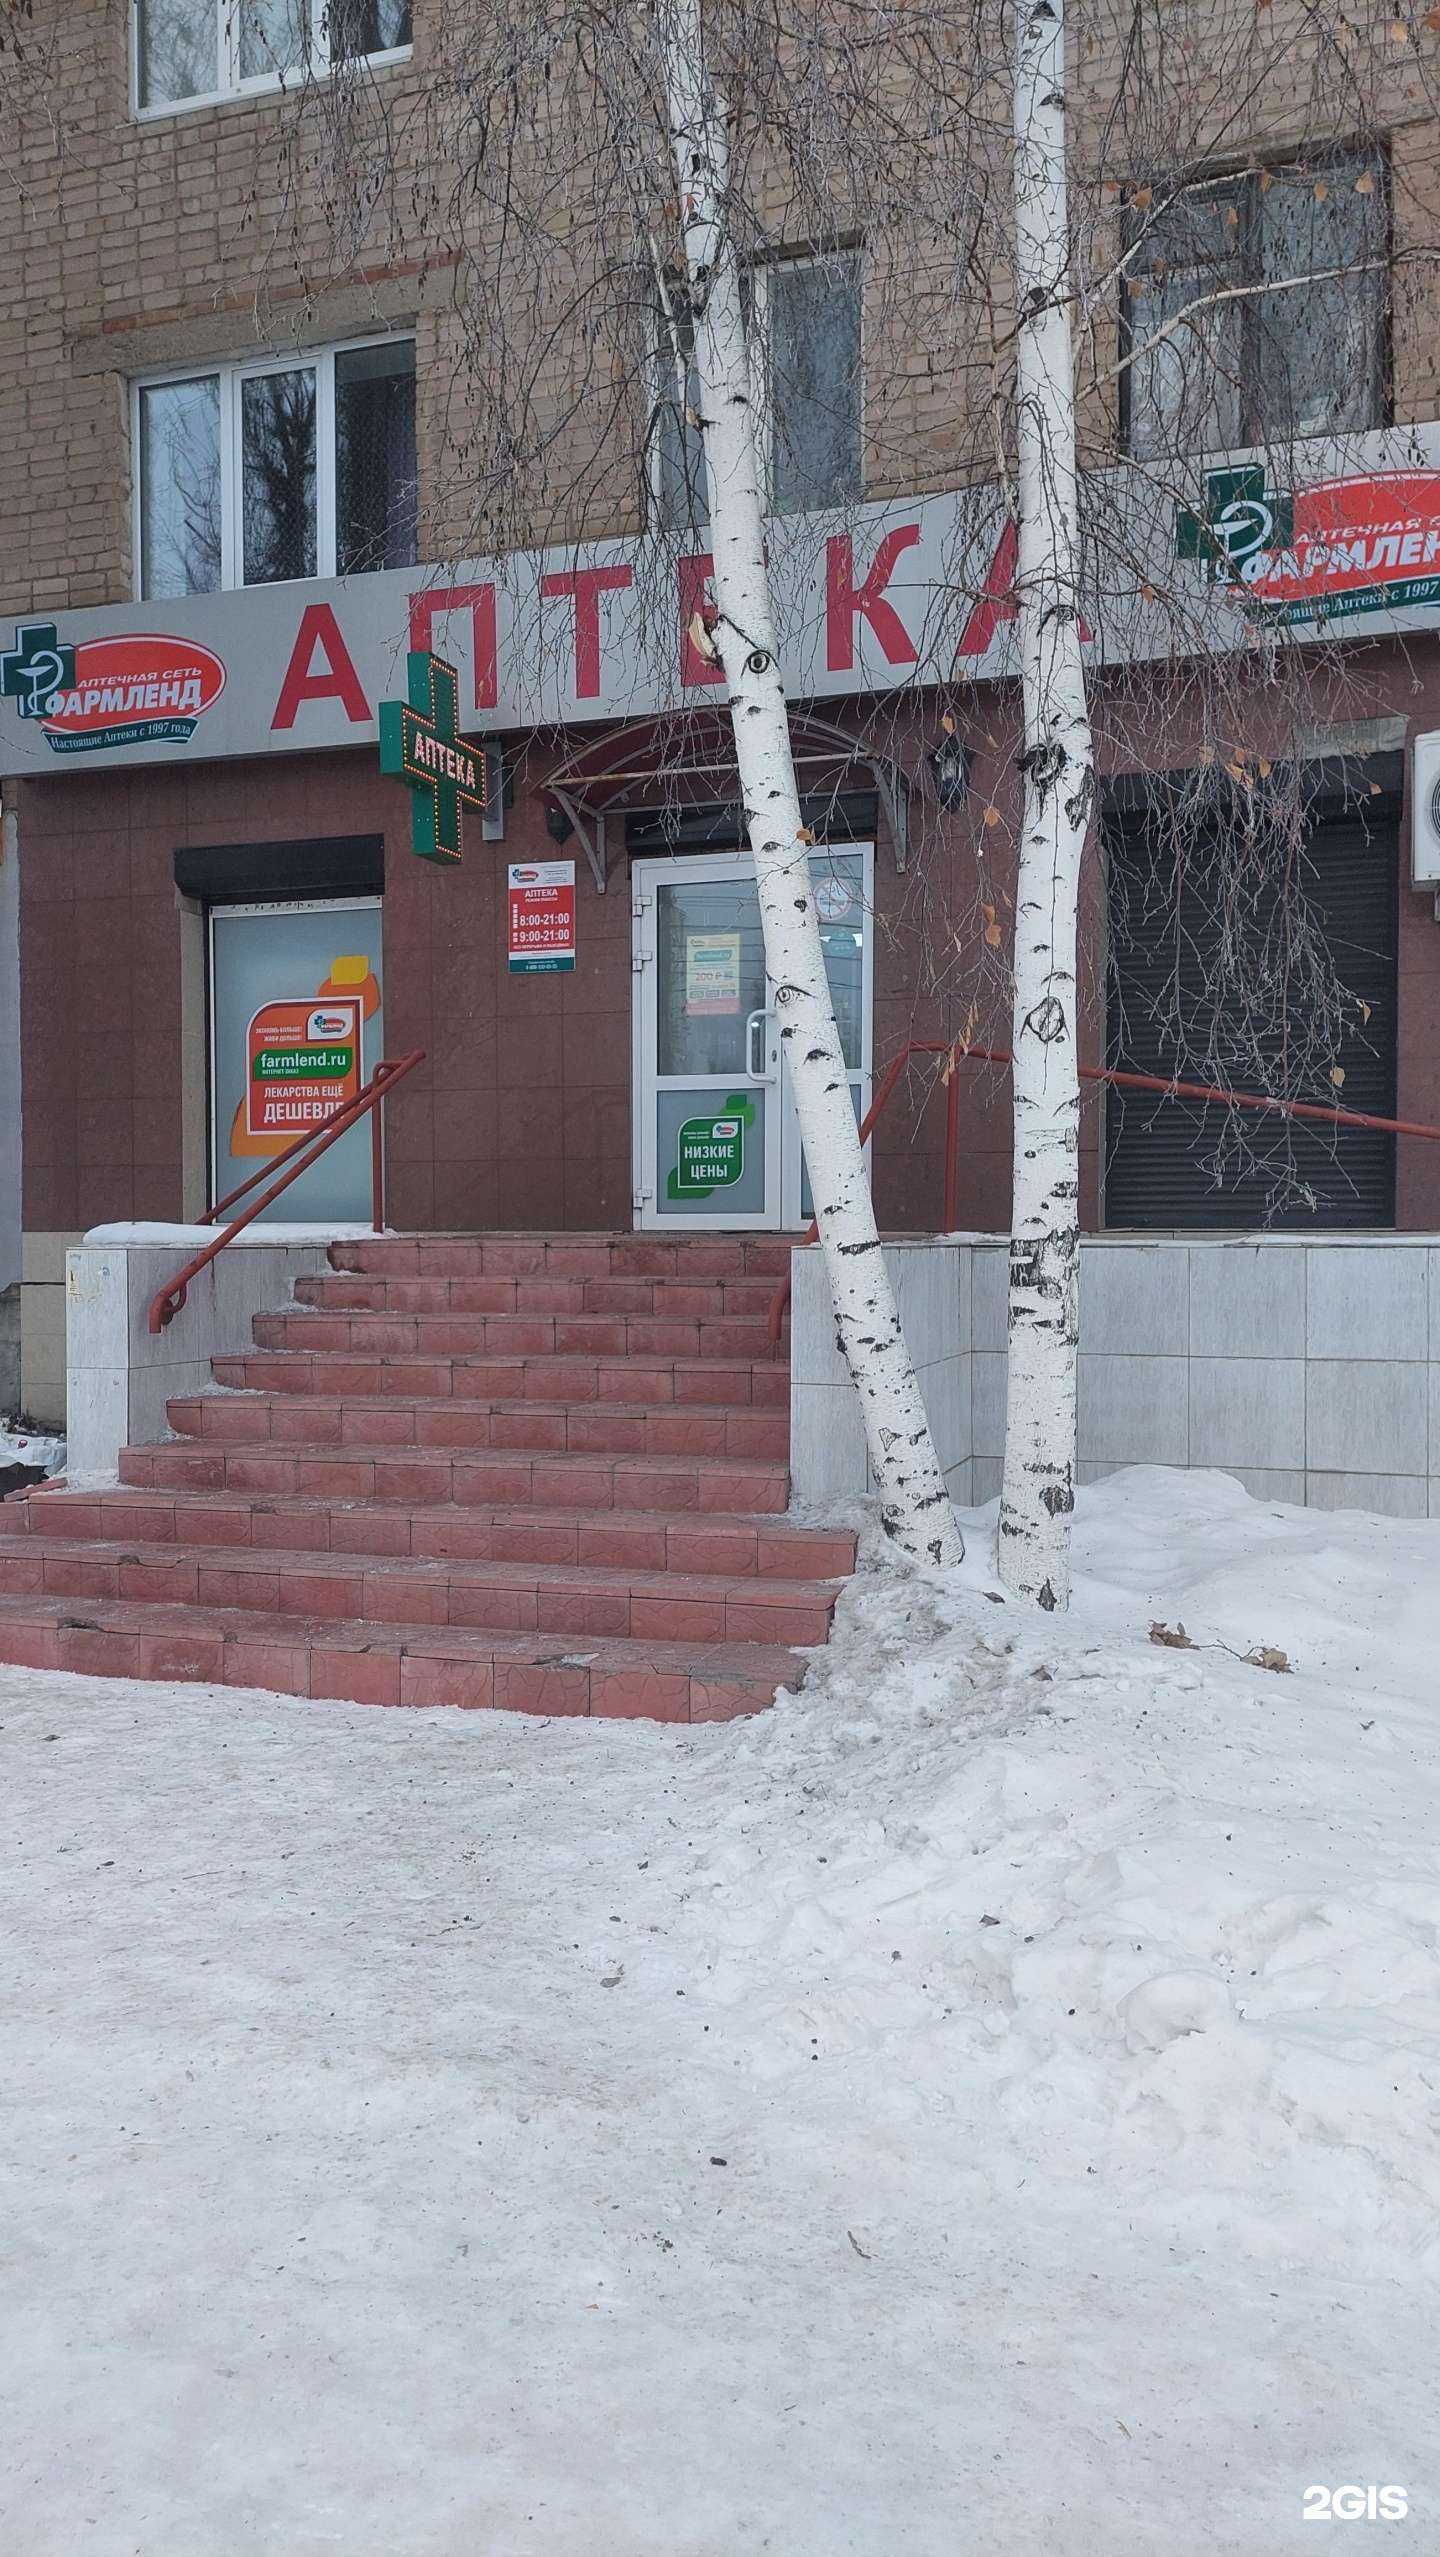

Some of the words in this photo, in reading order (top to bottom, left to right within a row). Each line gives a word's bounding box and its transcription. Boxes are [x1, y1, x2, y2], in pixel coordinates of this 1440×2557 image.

[1334, 593, 1387, 611] Аптек
[1391, 589, 1400, 600] с
[1404, 580, 1439, 598] 1997
[77, 673, 158, 688] АПТЕЧНАЯ
[162, 668, 202, 680] СЕТЬ
[44, 679, 201, 717] ФАРМЛЕНД
[51, 734, 102, 749] Настоящие
[104, 729, 138, 743] Аптеки
[147, 722, 169, 735] 1997
[170, 724, 191, 735] года
[414, 730, 476, 790] АПТЕКА
[524, 888, 558, 898] АПТЕКА
[519, 912, 570, 927] 8:00-21:00
[519, 929, 570, 942] 9:00-21:00
[261, 1052, 346, 1068] farmlend.ru
[264, 1086, 320, 1098] ЛЕКАРСТВА
[684, 1145, 735, 1159] НИЗКИЕ
[690, 1164, 728, 1180] ЦЕНЫ
